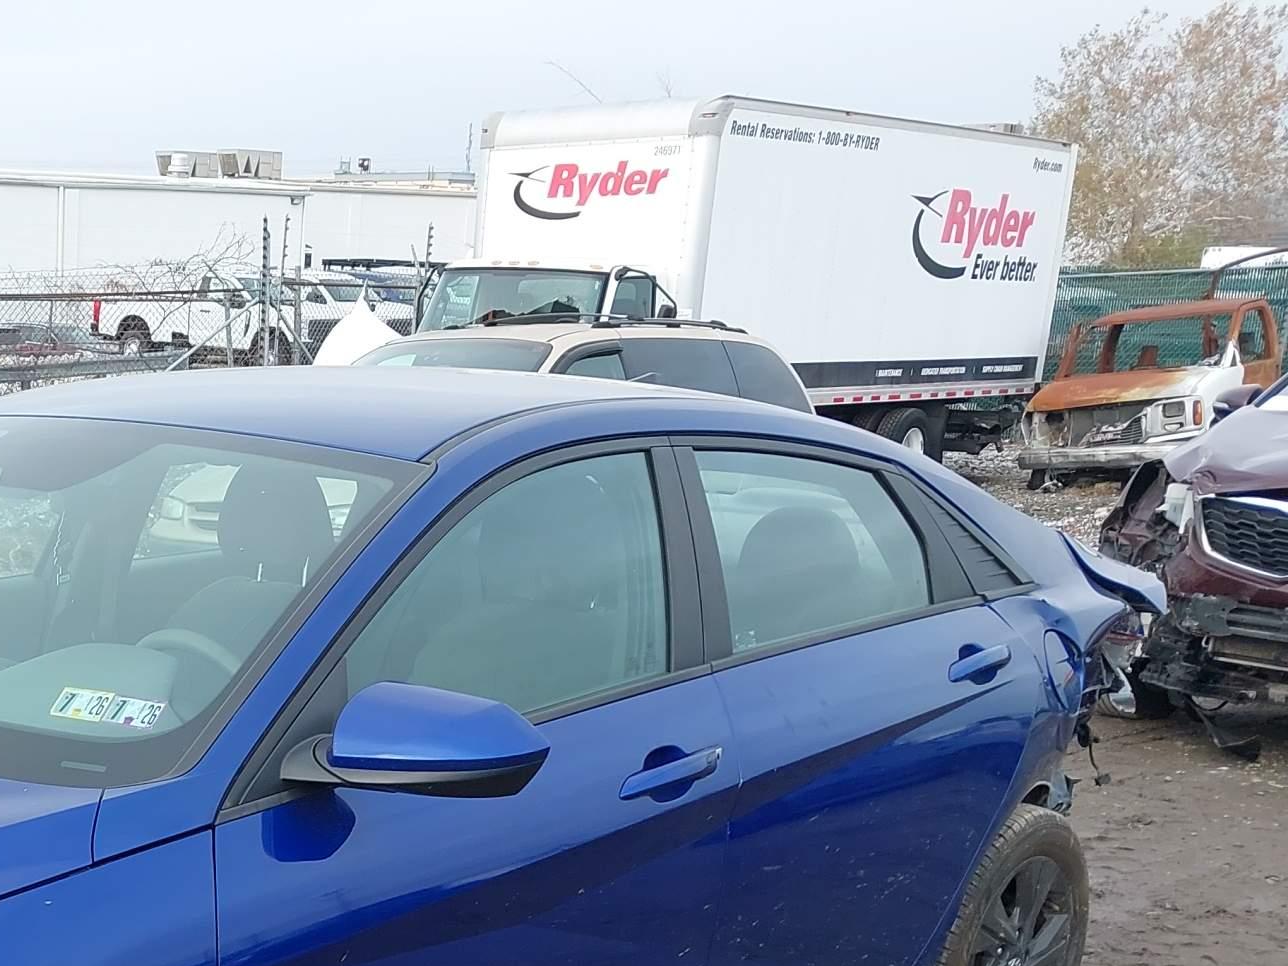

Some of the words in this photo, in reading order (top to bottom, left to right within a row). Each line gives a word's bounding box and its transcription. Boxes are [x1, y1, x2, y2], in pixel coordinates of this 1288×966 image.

[730, 120, 758, 137] Rental
[760, 123, 816, 144] Reservations:
[817, 131, 880, 151] 1-800-BY-RYDER
[1032, 157, 1063, 173] Ryder.com
[546, 160, 670, 206] Ryder
[940, 188, 1036, 259] Ryder
[971, 253, 1000, 281] Ever
[1000, 254, 1038, 282] better.
[88, 696, 109, 716] 26
[141, 704, 161, 725] 26
